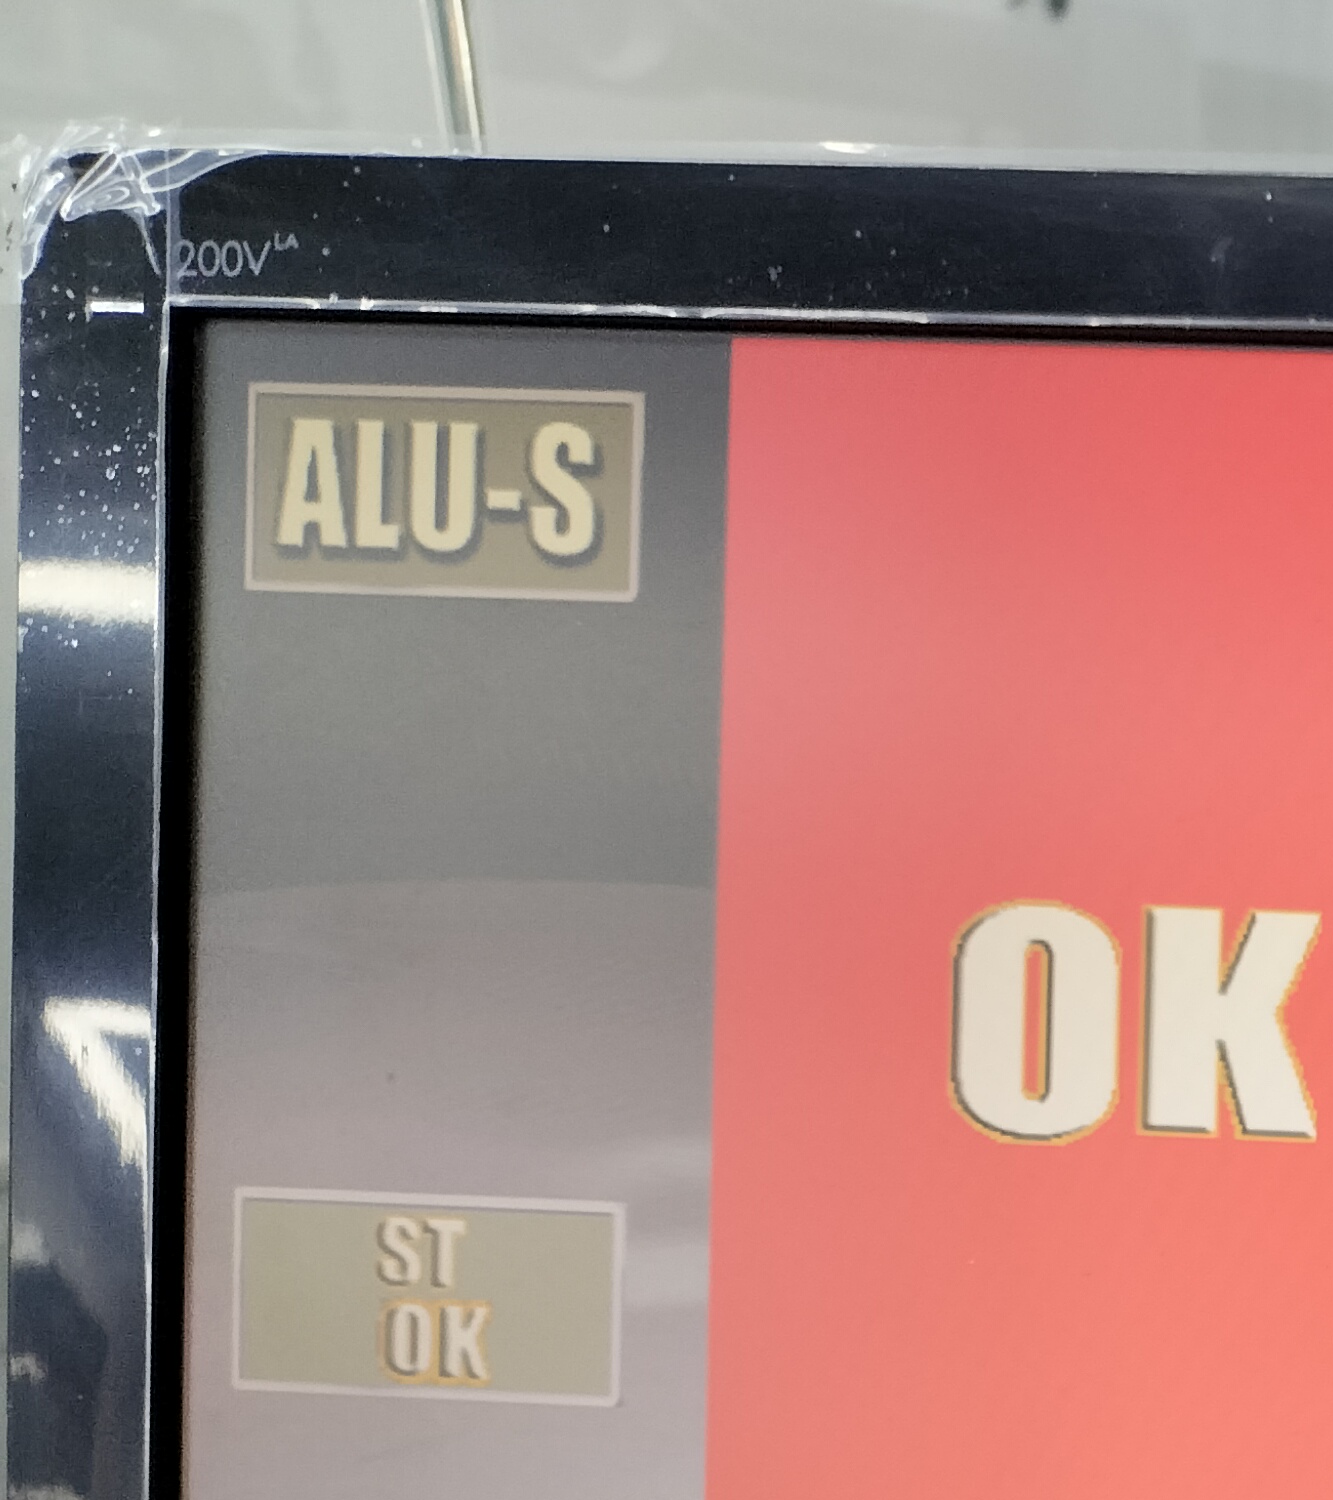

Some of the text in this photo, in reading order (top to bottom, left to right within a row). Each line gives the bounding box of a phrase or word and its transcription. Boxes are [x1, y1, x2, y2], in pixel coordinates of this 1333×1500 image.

[277, 417, 599, 558] ALU-S
[949, 899, 1322, 1146] OK
[376, 1215, 468, 1289] ST
[379, 1299, 493, 1385] OK
